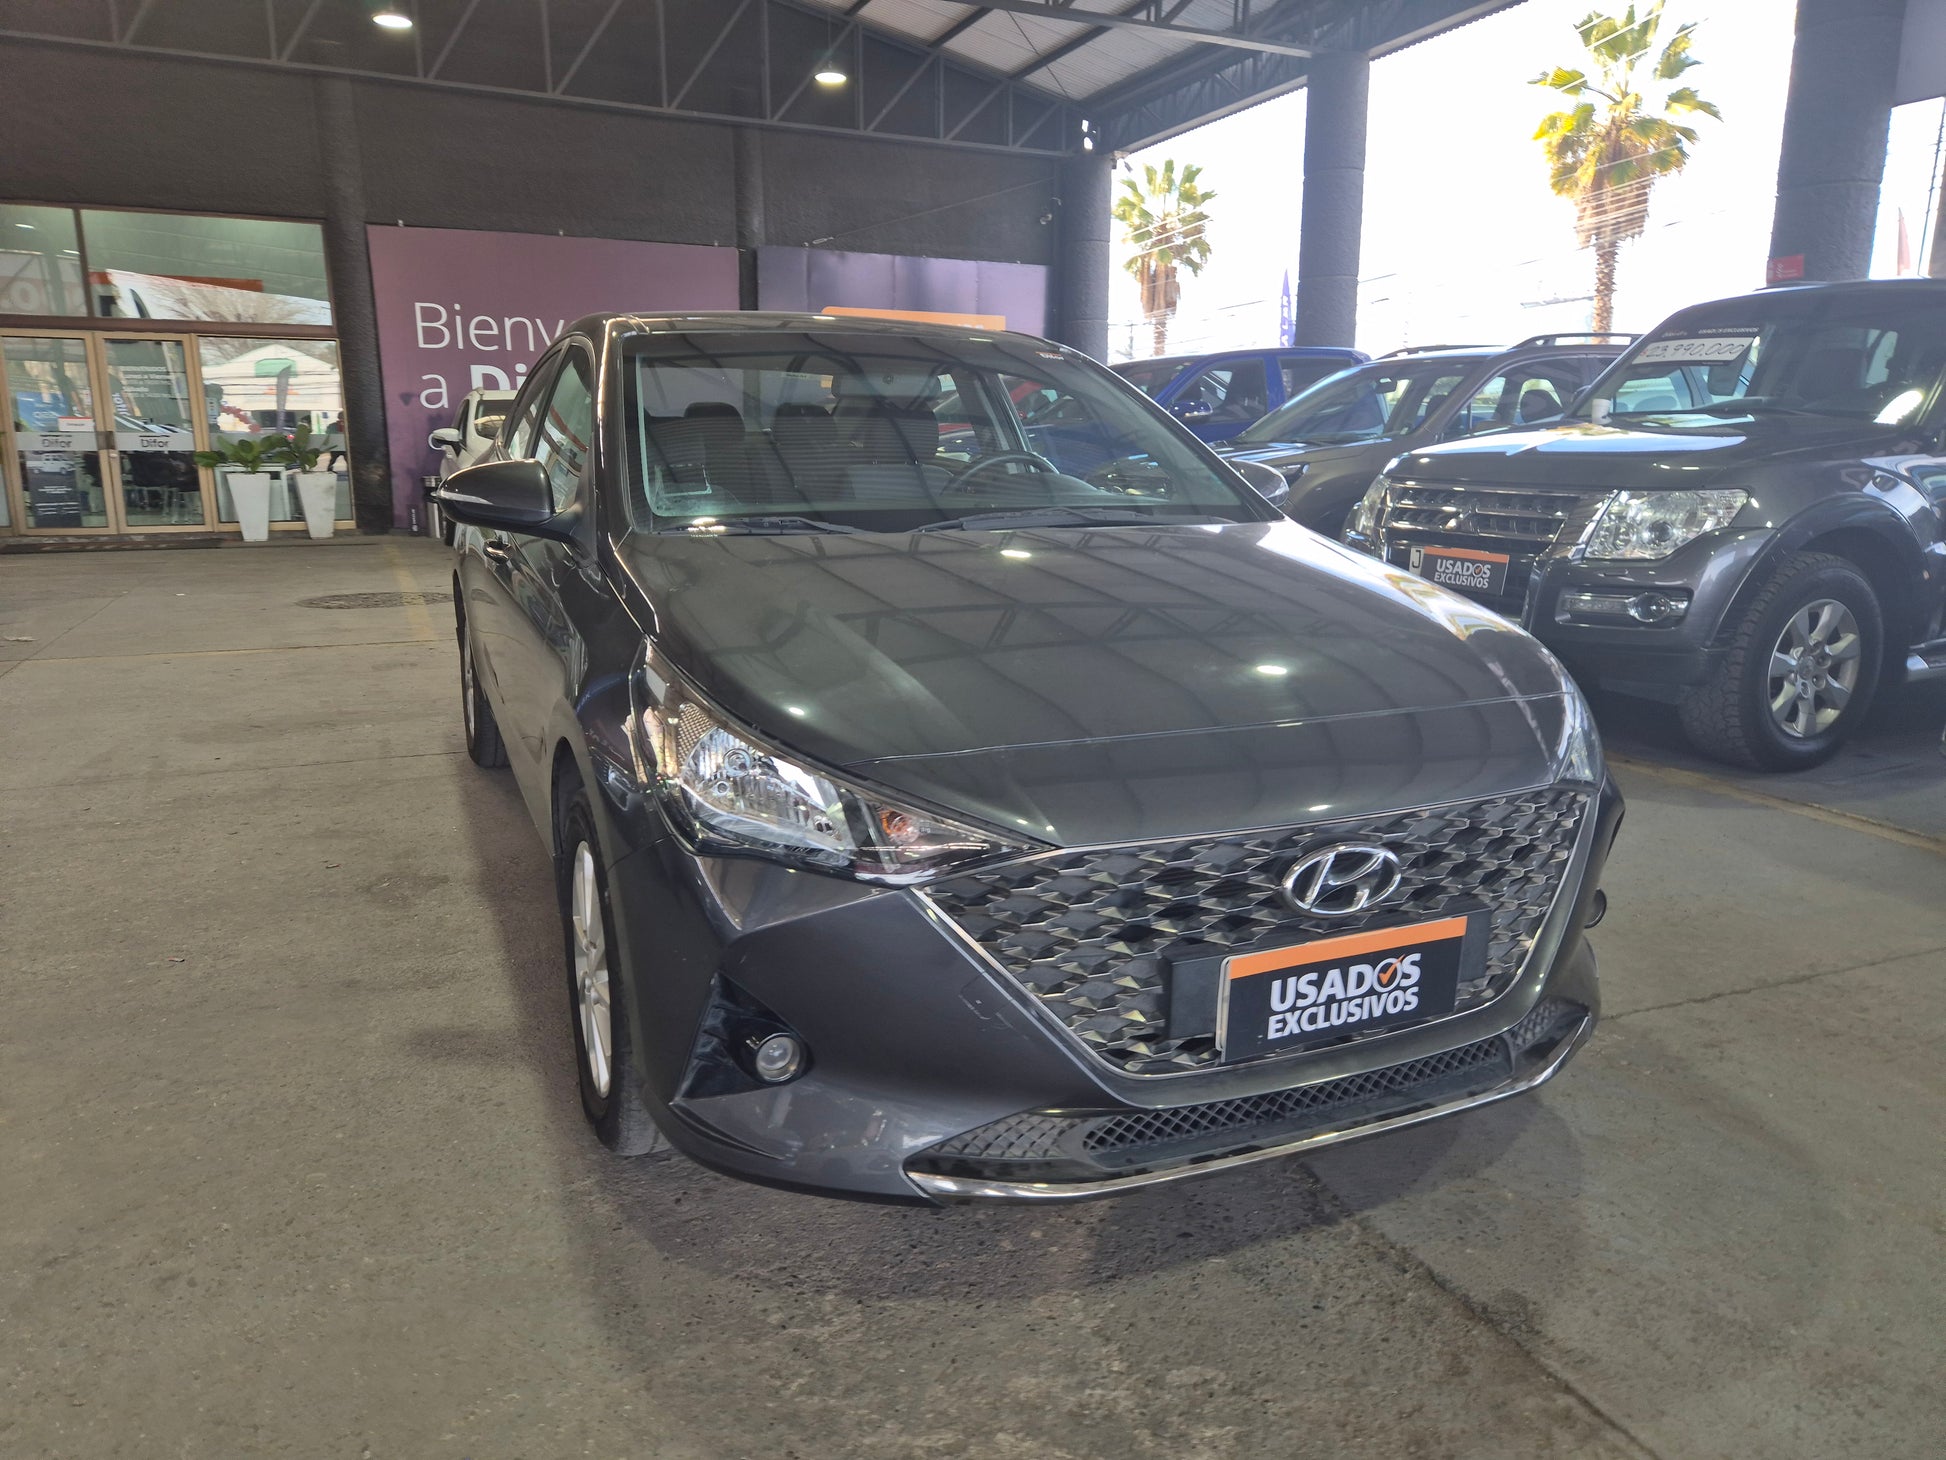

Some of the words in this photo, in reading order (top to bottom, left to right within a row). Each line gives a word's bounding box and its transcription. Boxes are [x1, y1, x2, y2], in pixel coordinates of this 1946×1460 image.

[419, 374, 449, 409] a
[141, 438, 169, 448] Difor
[1434, 572, 1489, 589] EXCLUSIVOS
[1436, 558, 1491, 578] USADOS
[1270, 953, 1422, 1012] USADOS
[1267, 986, 1420, 1040] EXCLUSIVOS
